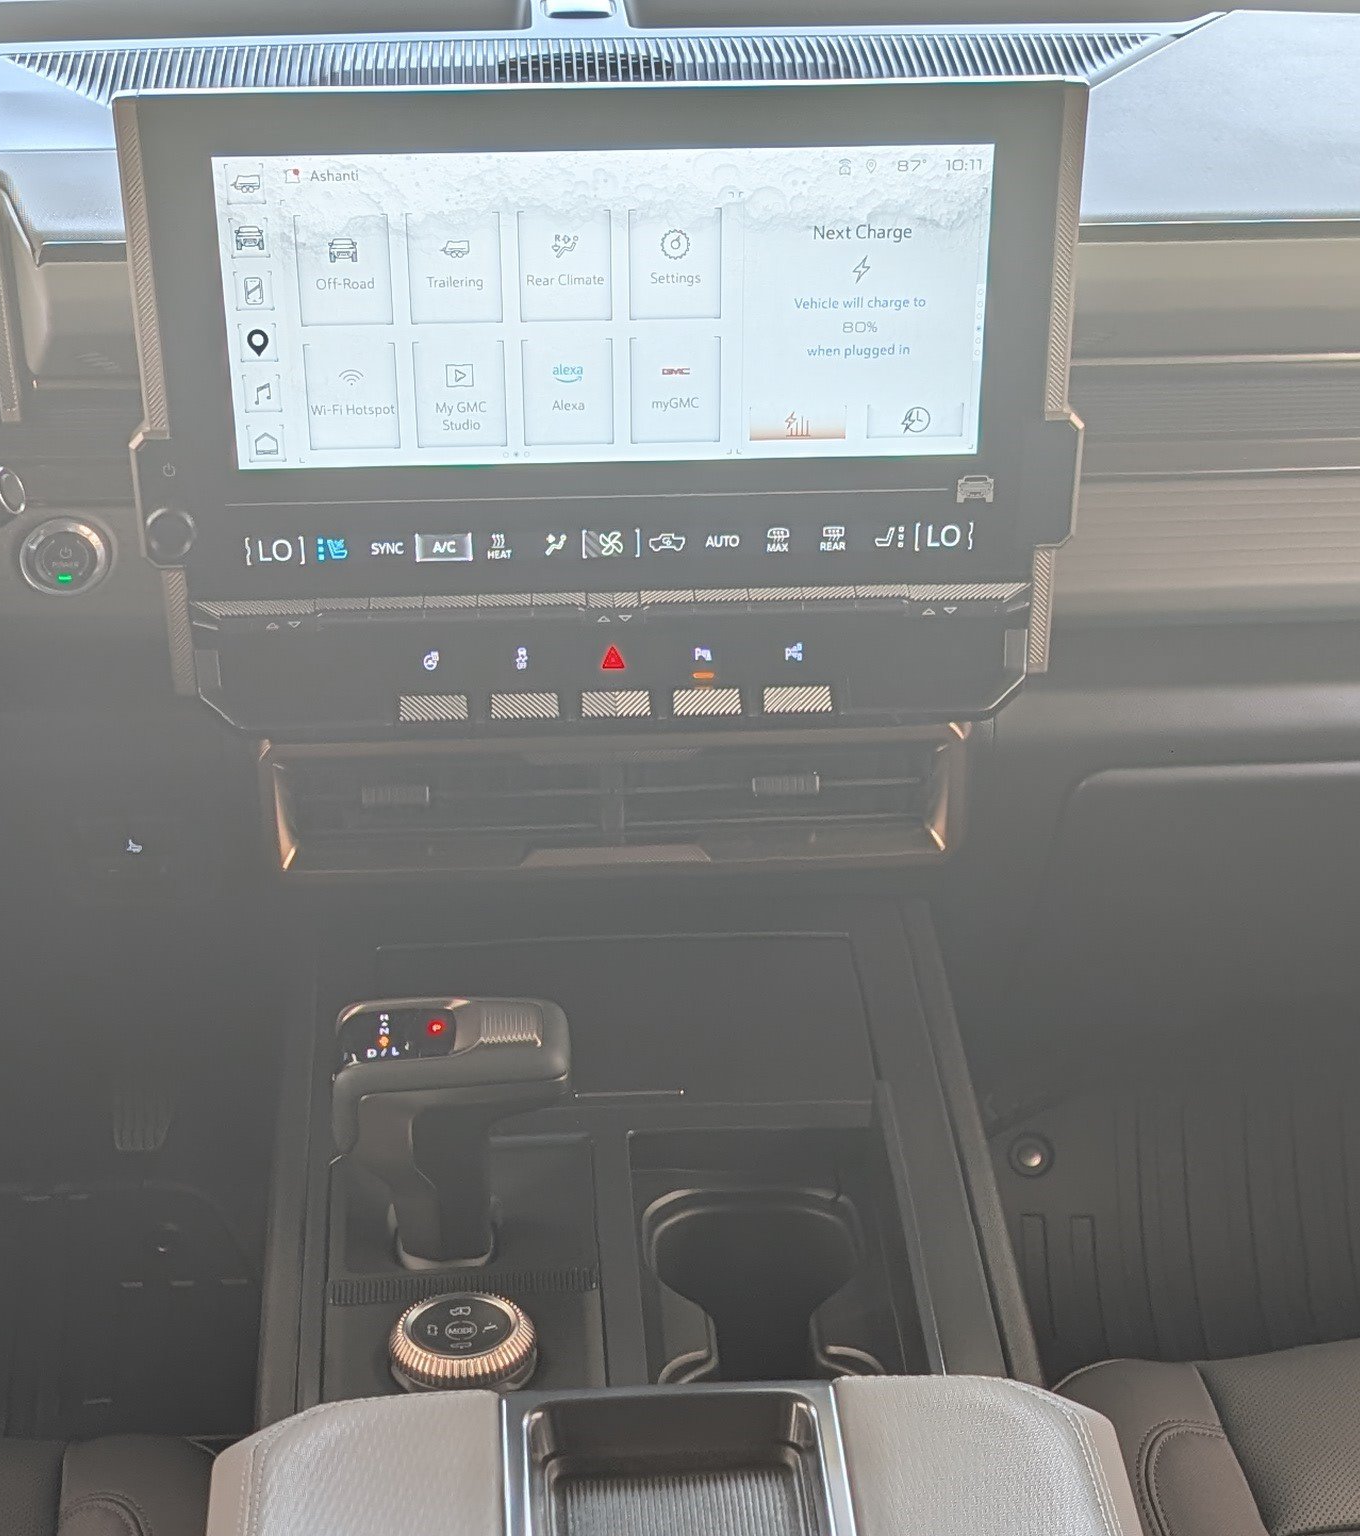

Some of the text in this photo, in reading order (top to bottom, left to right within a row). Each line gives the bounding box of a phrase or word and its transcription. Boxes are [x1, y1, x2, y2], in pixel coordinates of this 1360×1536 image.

[945, 159, 983, 171] 10:11
[309, 169, 359, 182] Ashanti
[813, 224, 913, 243] Next Charge
[316, 278, 375, 291] Off-Road
[426, 275, 484, 291] Trailering
[526, 273, 605, 286] Rear Climate
[650, 271, 702, 287] Settings
[794, 296, 926, 311] Vehicle will charge to
[842, 321, 878, 333] 80%
[806, 344, 911, 359] when plugged in
[552, 363, 584, 376] alexa
[310, 403, 396, 418] Wi-Fi Hotspot
[435, 401, 487, 415] My GMC
[552, 400, 585, 411] Alexa
[651, 397, 700, 411] myGMC
[442, 419, 481, 431] Studio
[705, 534, 740, 548] AUTO
[926, 524, 962, 548] LO
[258, 539, 292, 562] LO
[371, 542, 405, 555] SYNC
[432, 541, 457, 554] A/C
[766, 542, 789, 552] MAX
[819, 541, 846, 551] REAR
[487, 549, 513, 560] HEAT
[448, 1326, 472, 1335] MODE
